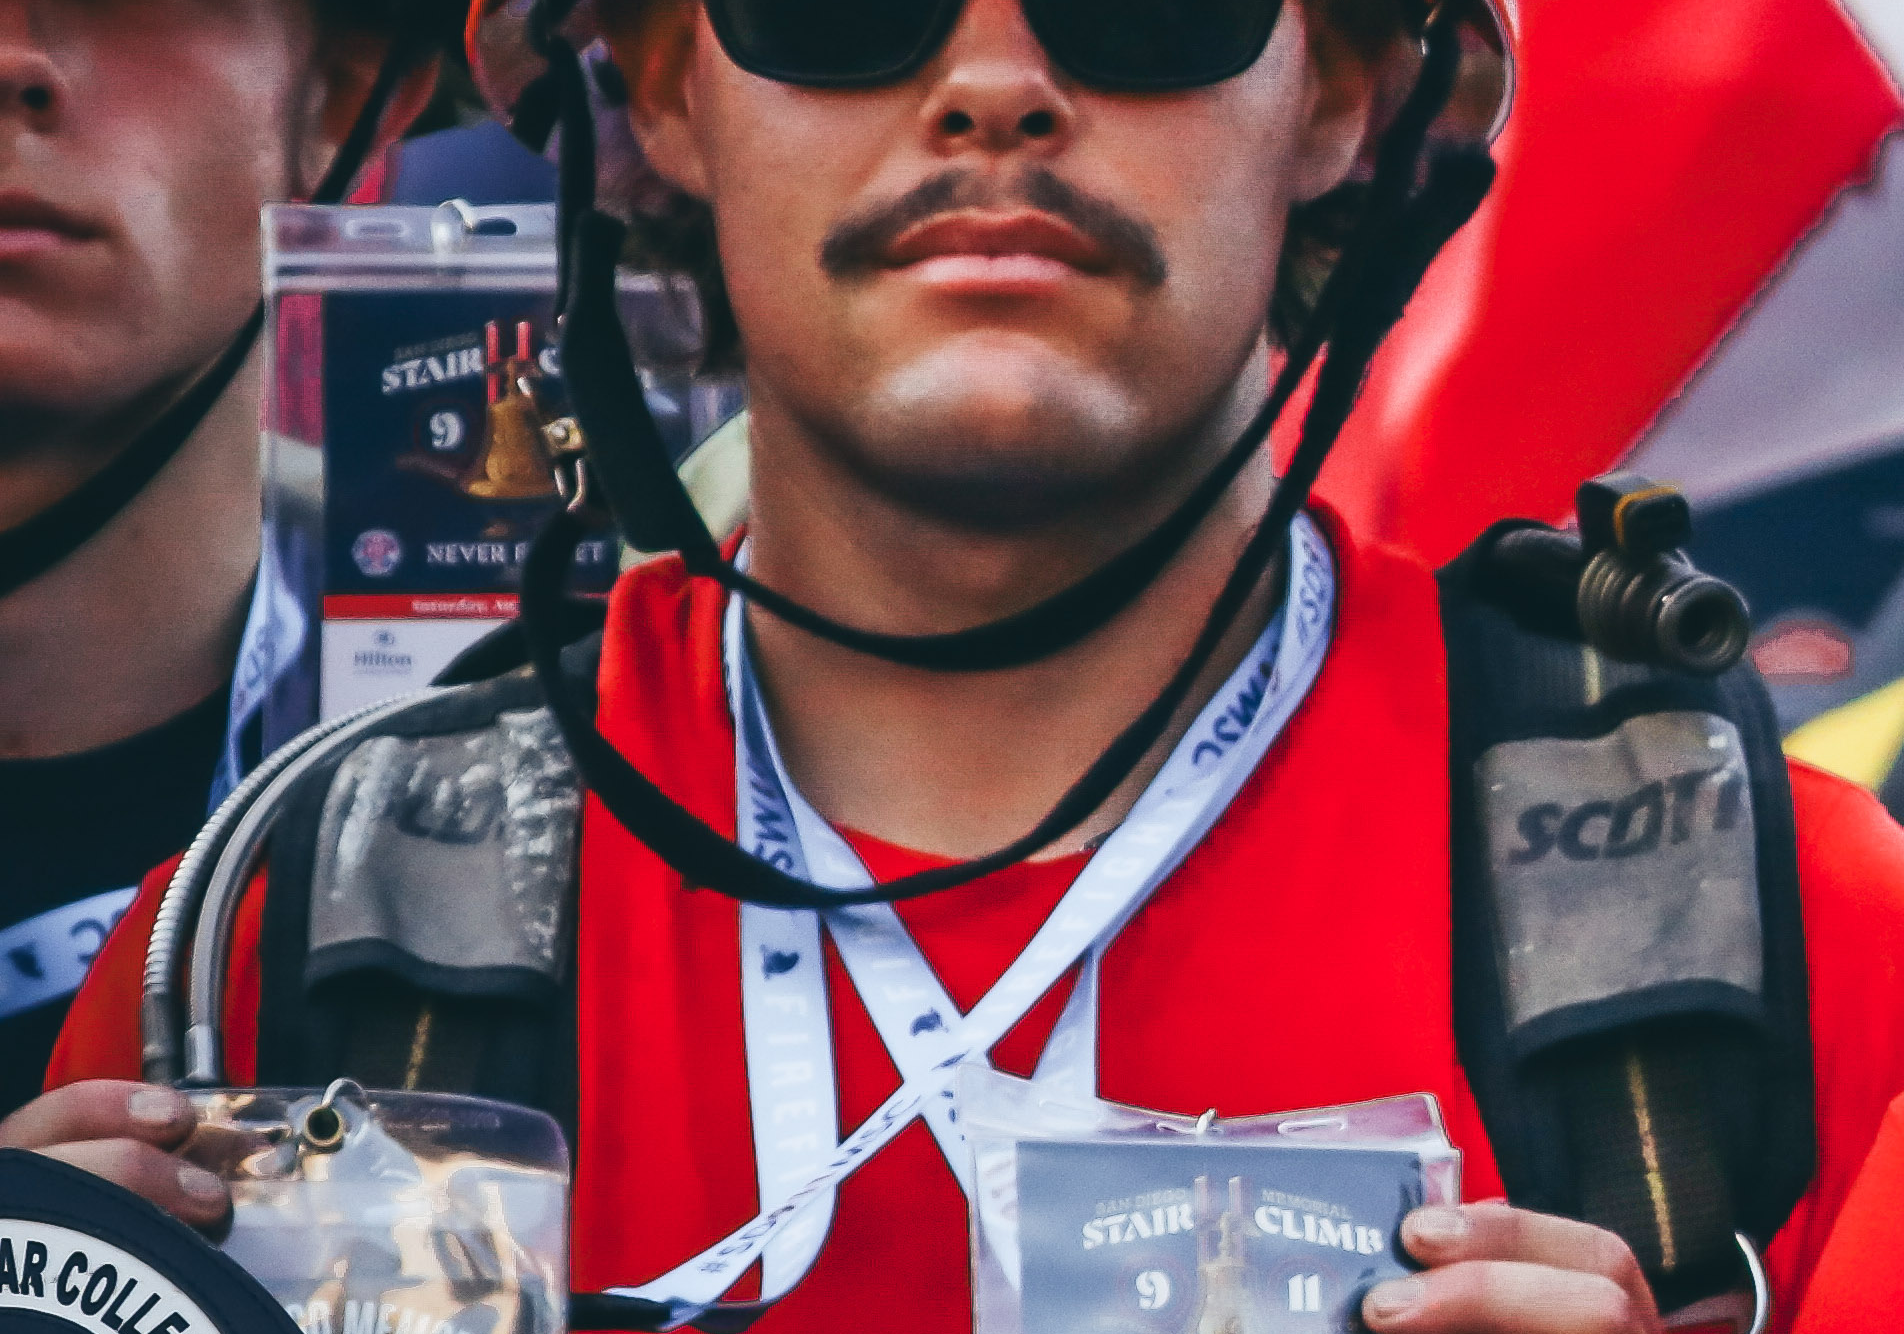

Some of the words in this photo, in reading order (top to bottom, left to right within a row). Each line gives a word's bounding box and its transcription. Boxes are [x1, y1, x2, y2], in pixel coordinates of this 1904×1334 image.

[430, 410, 464, 451] 9
[427, 542, 505, 565] NEVER
[515, 540, 603, 564] FET
[1507, 767, 1745, 866] SCOTT
[1082, 1203, 1195, 1251] STAIR
[1254, 1205, 1385, 1257] CLIMB
[1135, 1271, 1171, 1310] 9
[1287, 1273, 1320, 1312] 11
